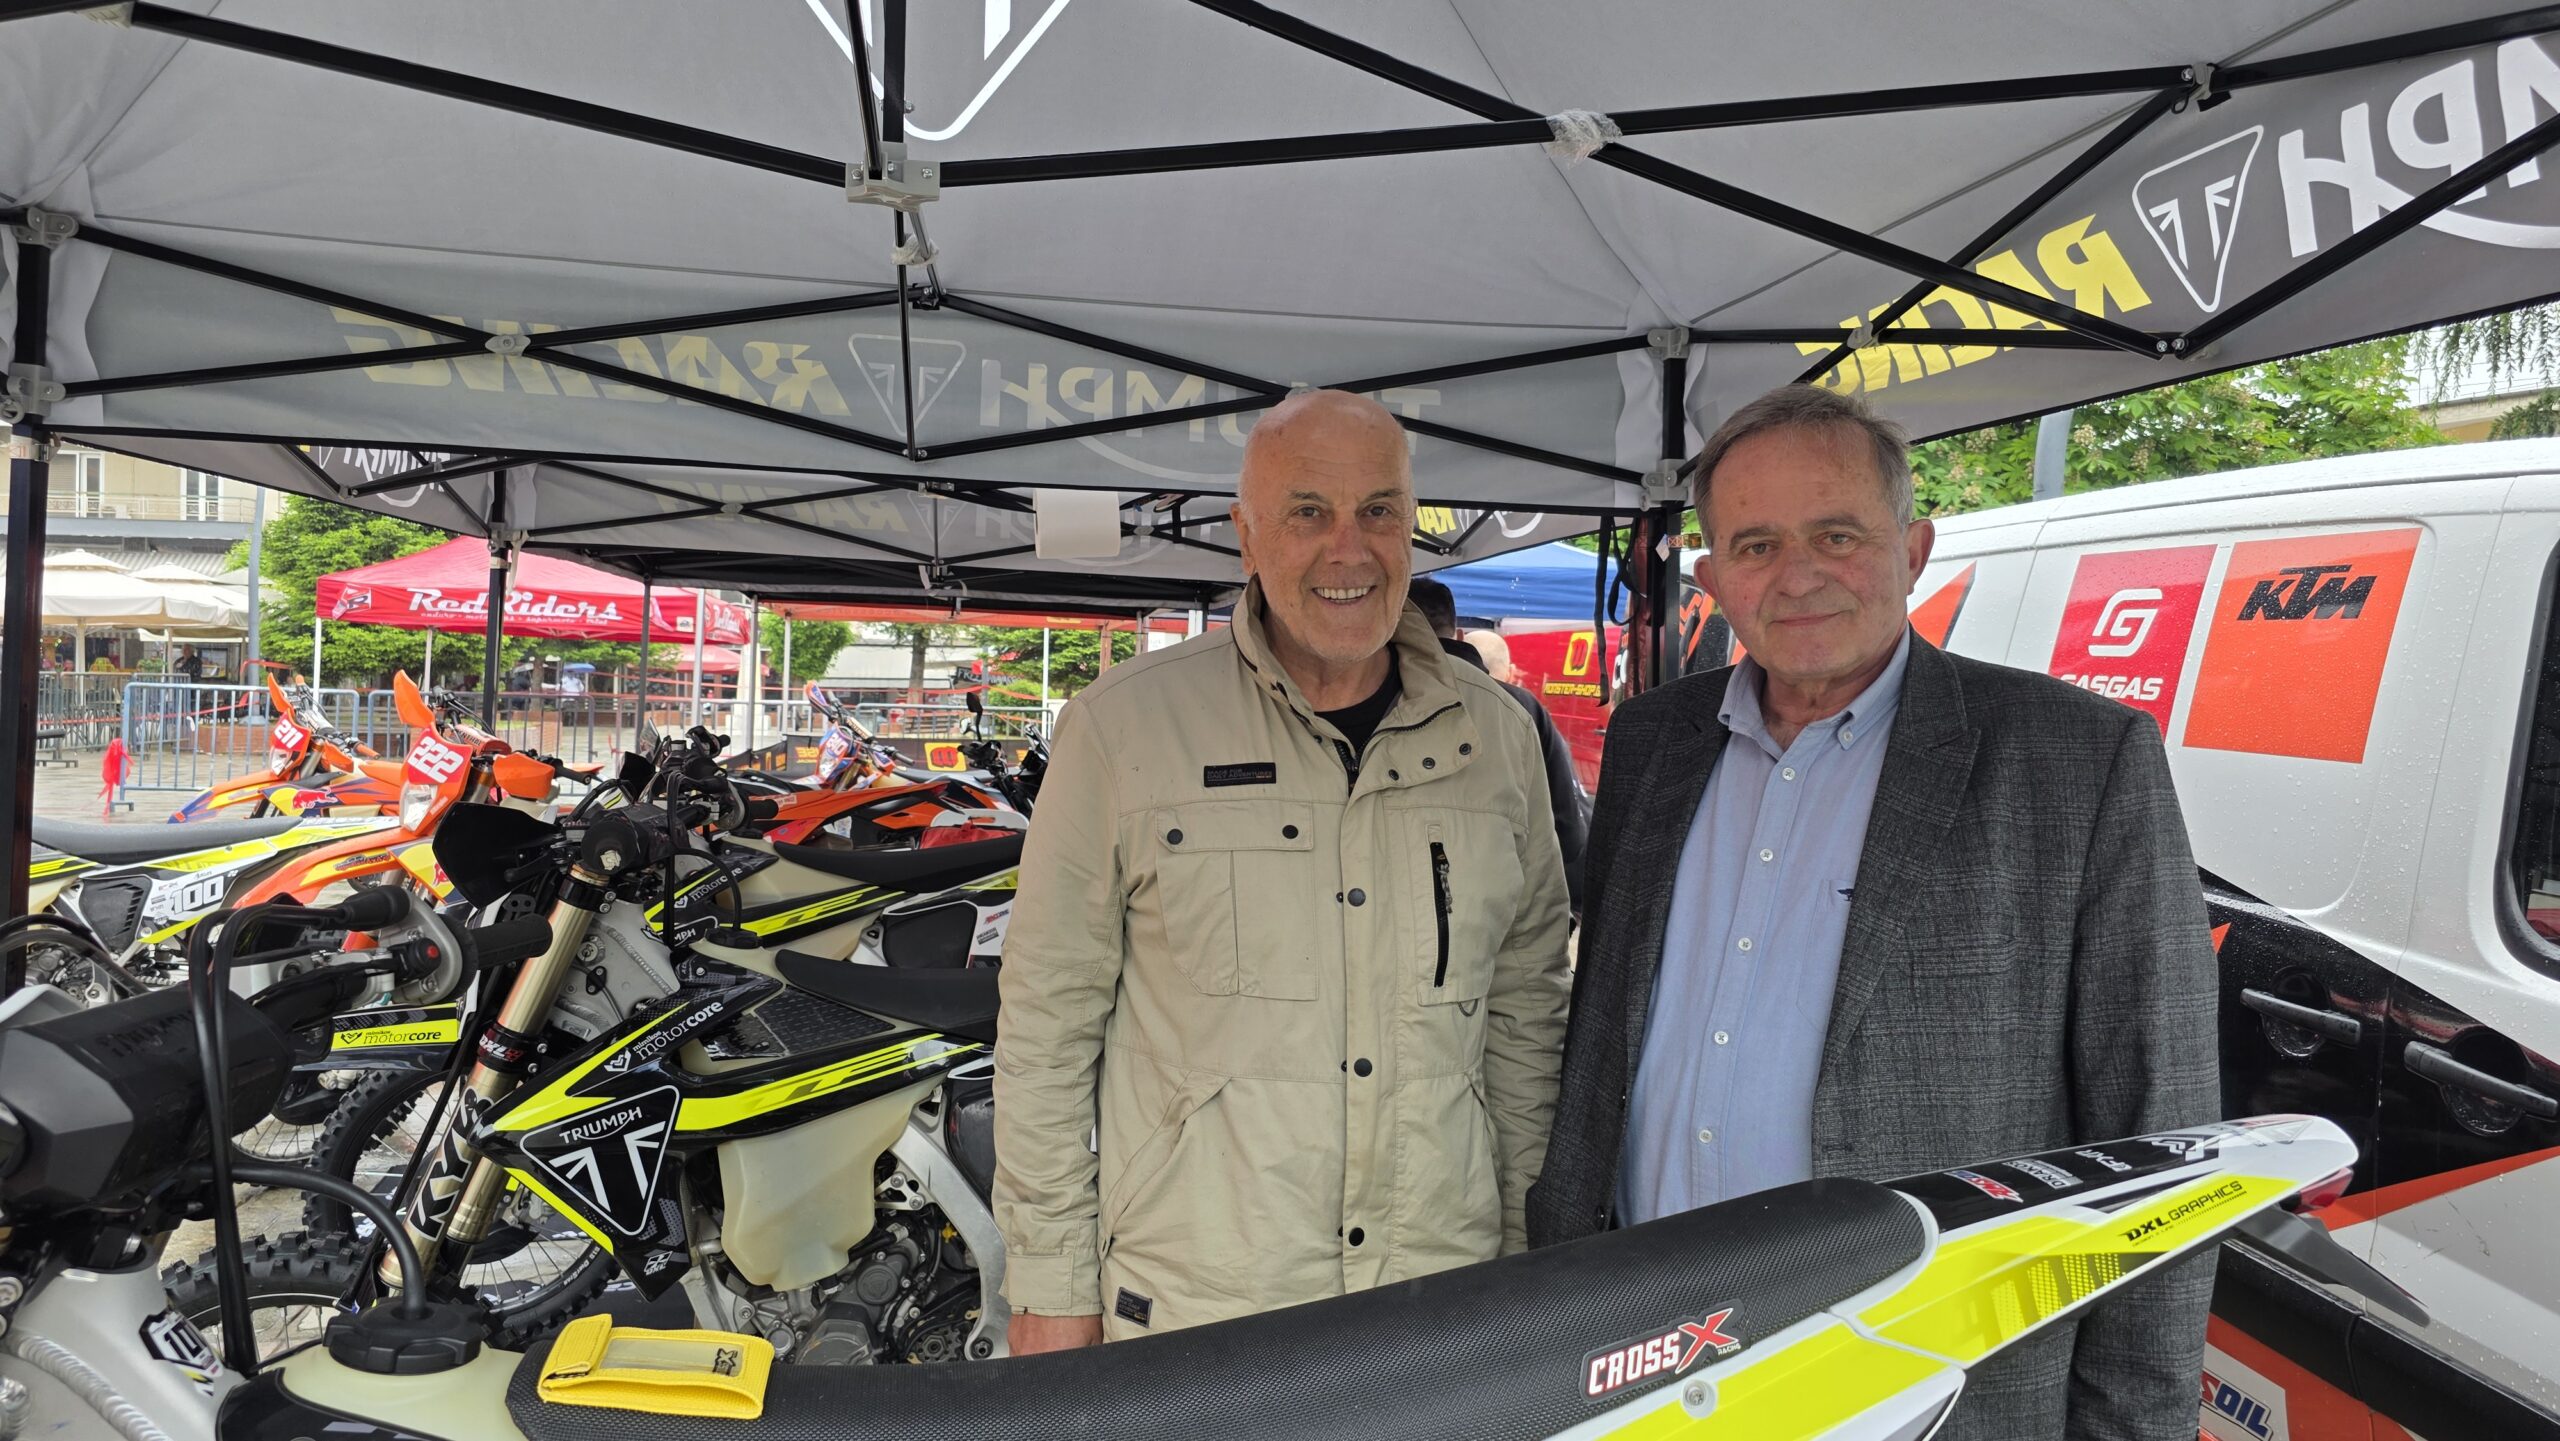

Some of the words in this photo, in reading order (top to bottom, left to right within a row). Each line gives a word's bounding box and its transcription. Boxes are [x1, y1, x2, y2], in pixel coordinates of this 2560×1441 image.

[2236, 564, 2378, 621] KTM
[273, 719, 305, 750] 211
[406, 735, 465, 784] 222
[170, 875, 224, 915] 100
[690, 866, 743, 902] motorcre
[363, 1031, 442, 1045] motorcore
[635, 1000, 724, 1061] motorcore
[559, 1106, 643, 1144] TRIUMPH
[1717, 1342, 1742, 1356] RACING
